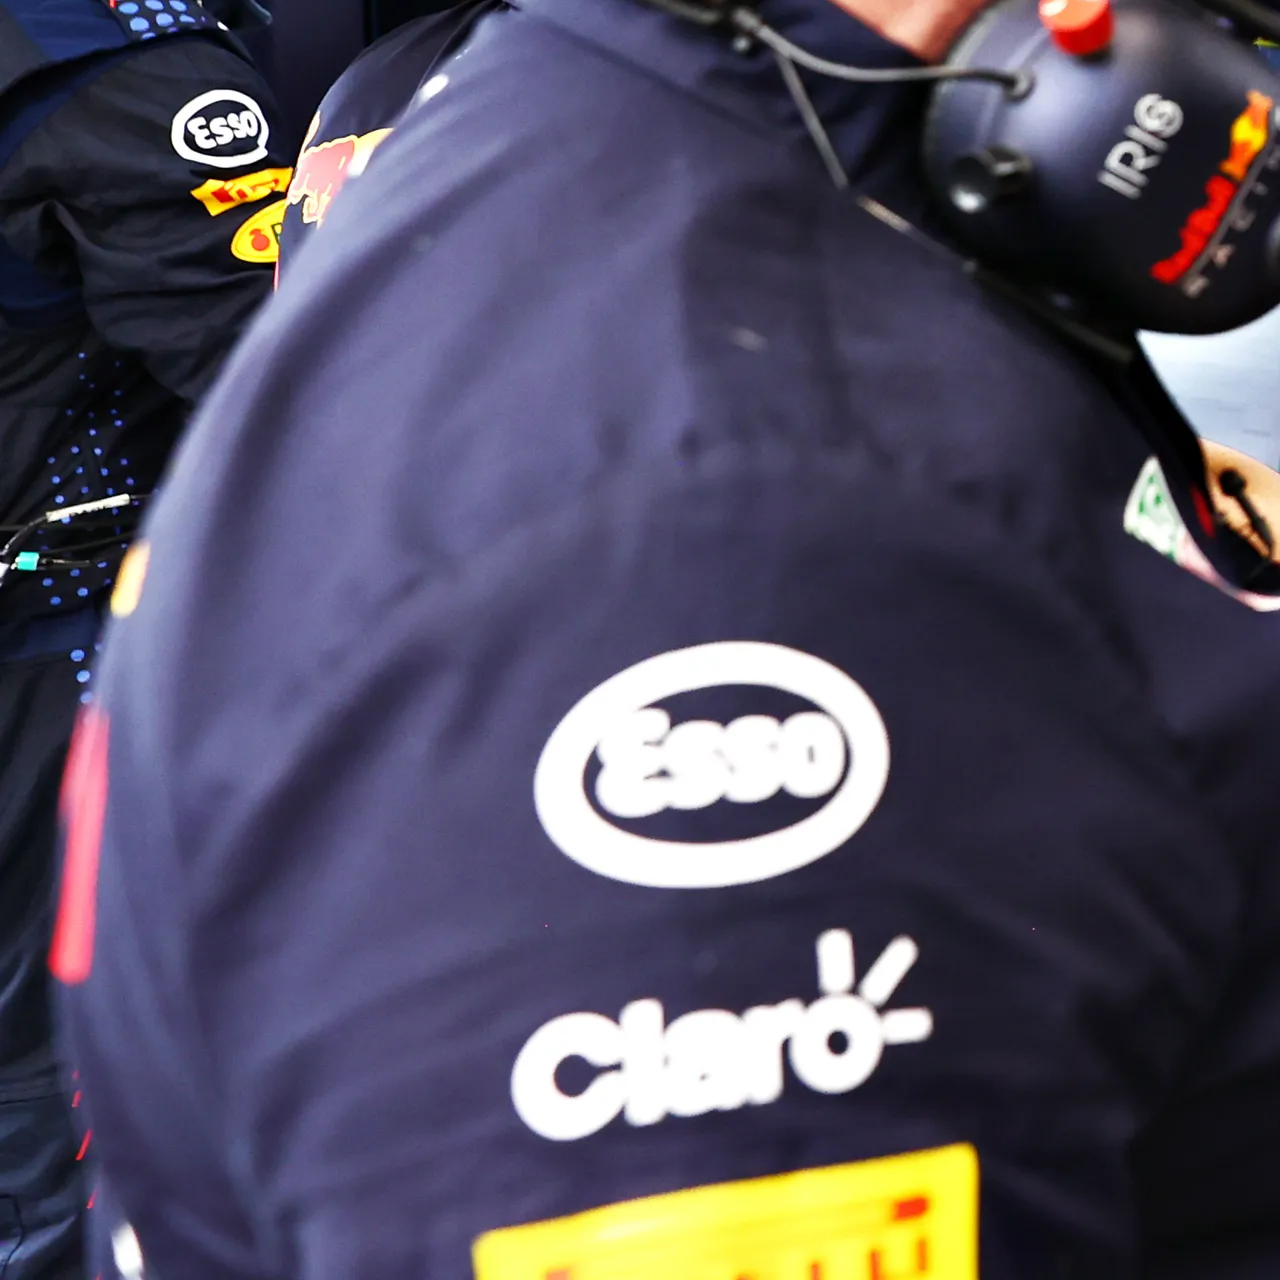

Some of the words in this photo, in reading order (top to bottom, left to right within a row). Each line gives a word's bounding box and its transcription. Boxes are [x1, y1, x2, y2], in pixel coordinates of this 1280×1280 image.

[186, 109, 259, 151] Esso
[1097, 93, 1184, 200] IRIS
[594, 706, 847, 819] Esso
[510, 988, 885, 1141] Claro
